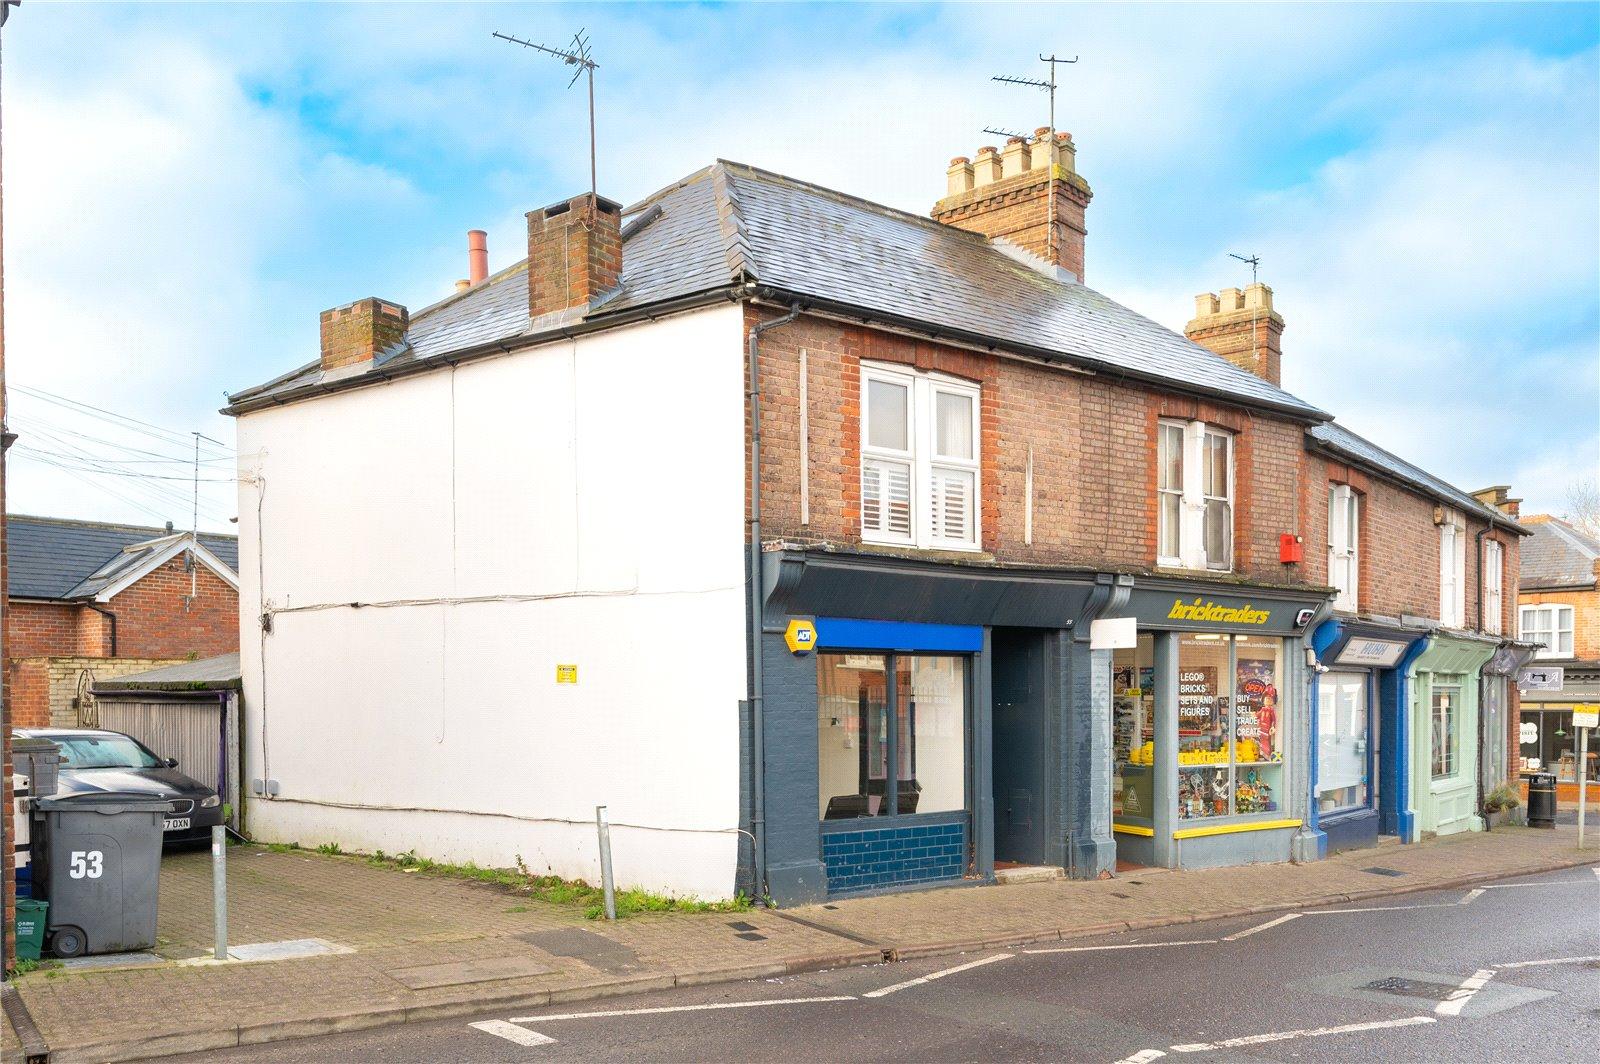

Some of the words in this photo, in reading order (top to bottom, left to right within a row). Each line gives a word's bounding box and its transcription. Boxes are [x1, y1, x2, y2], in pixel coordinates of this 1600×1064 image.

[1167, 597, 1270, 624] bricktraders
[798, 631, 811, 641] ADT
[1180, 684, 1206, 693] BRICKS
[1245, 683, 1265, 693] OPEN
[1180, 696, 1199, 705] SETS
[1200, 695, 1214, 704] AND
[1237, 694, 1251, 703] BUY
[1180, 707, 1210, 717] FIGURES
[1236, 705, 1252, 714] SELL
[1236, 716, 1259, 725] TRADE
[1236, 727, 1261, 737] CREATE
[172, 819, 189, 829] OXN
[69, 850, 104, 879] 53
